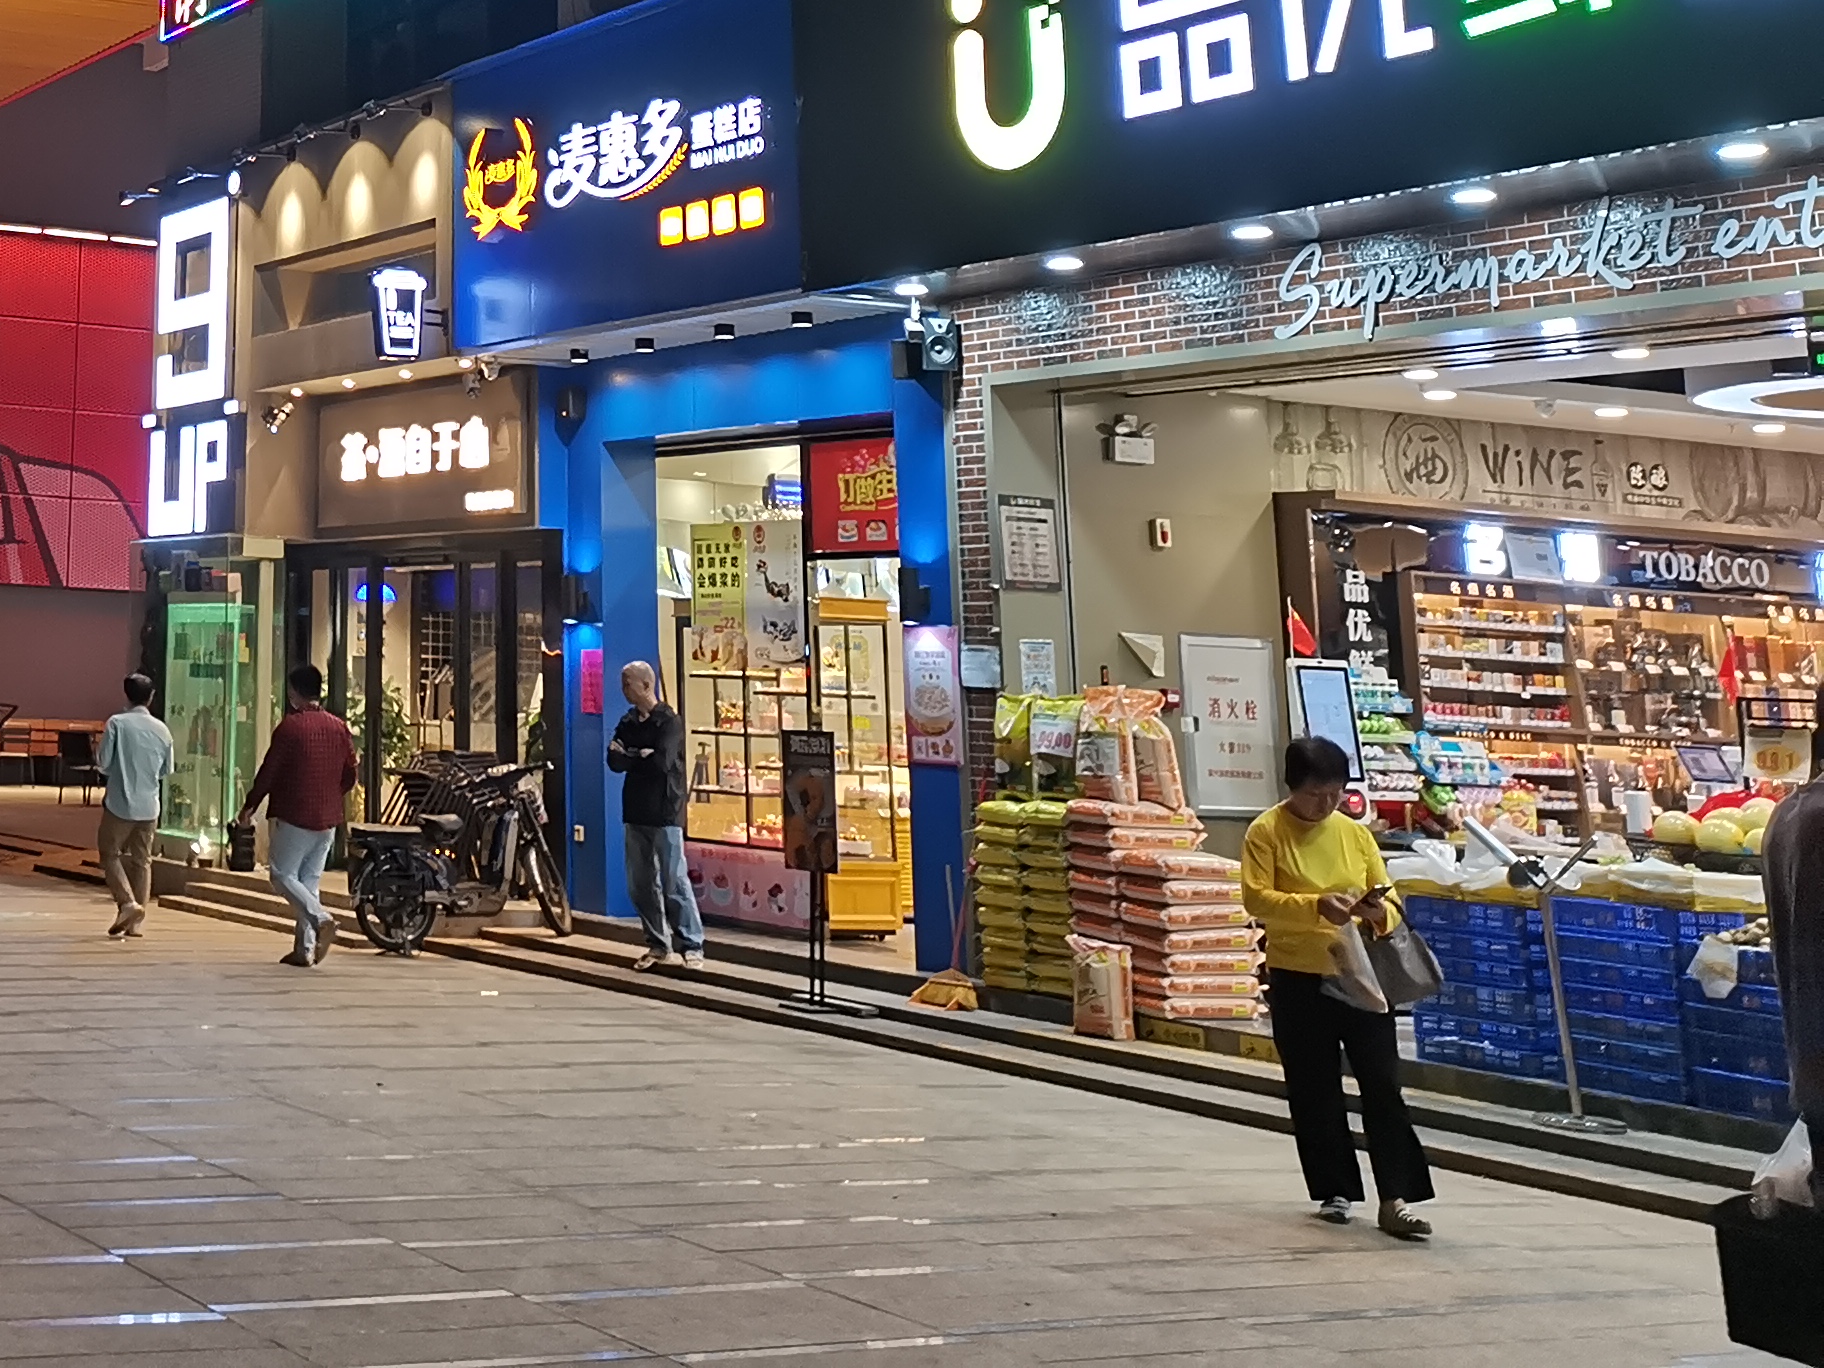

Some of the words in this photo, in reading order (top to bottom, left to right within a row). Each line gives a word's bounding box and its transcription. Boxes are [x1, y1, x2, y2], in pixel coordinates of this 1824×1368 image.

[545, 98, 685, 209] 麦惠多
[691, 97, 762, 150] 蛋糕店
[157, 196, 229, 409] 9
[1274, 195, 1706, 342] Supermarket
[147, 419, 228, 537] UP
[837, 470, 897, 506] 订做生
[1402, 434, 1448, 485] 酒
[1639, 548, 1770, 588] TOBACCO
[1208, 697, 1258, 721] 消火栓
